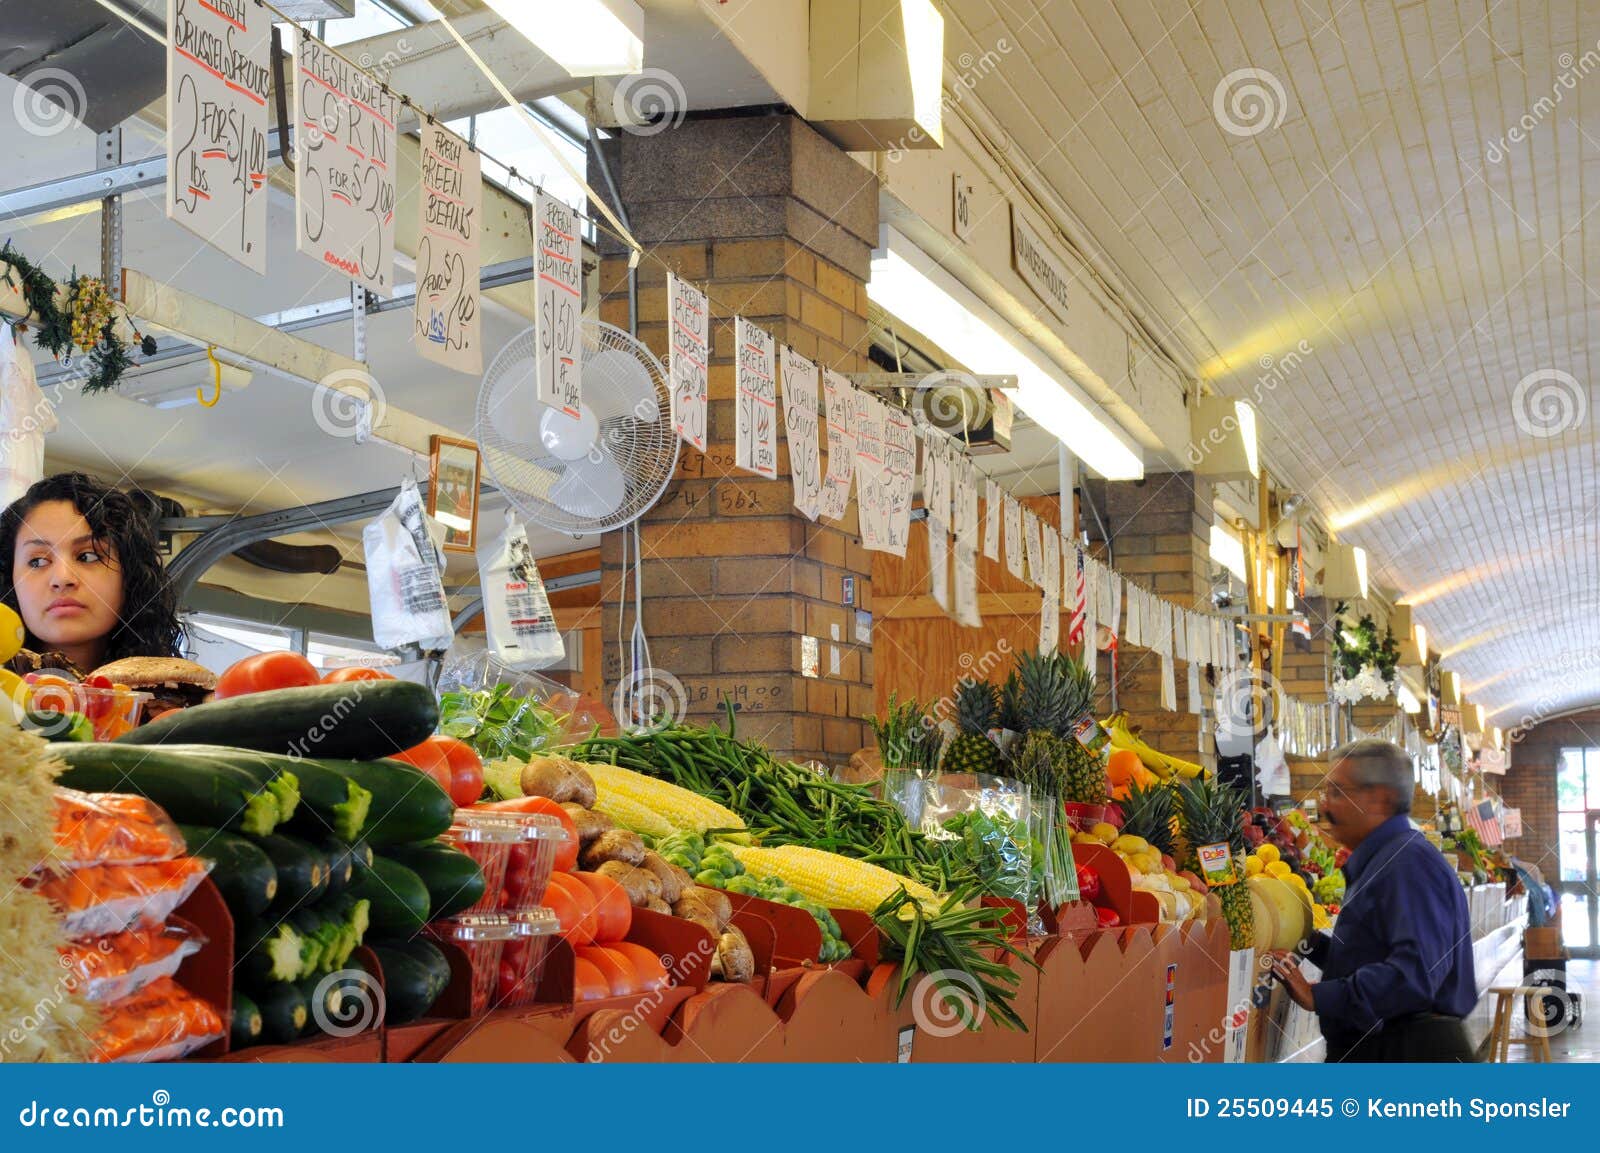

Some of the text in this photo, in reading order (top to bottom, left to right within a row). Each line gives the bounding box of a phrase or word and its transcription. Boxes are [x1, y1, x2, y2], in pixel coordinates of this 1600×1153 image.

[300, 39, 348, 95] FRESH
[201, 102, 228, 145] FOR
[302, 78, 386, 163] CORN
[434, 131, 462, 168] FRESH
[329, 166, 349, 191] FOR
[422, 147, 463, 197] GREEN
[426, 194, 473, 239] BEANS
[546, 202, 571, 235] FRESH
